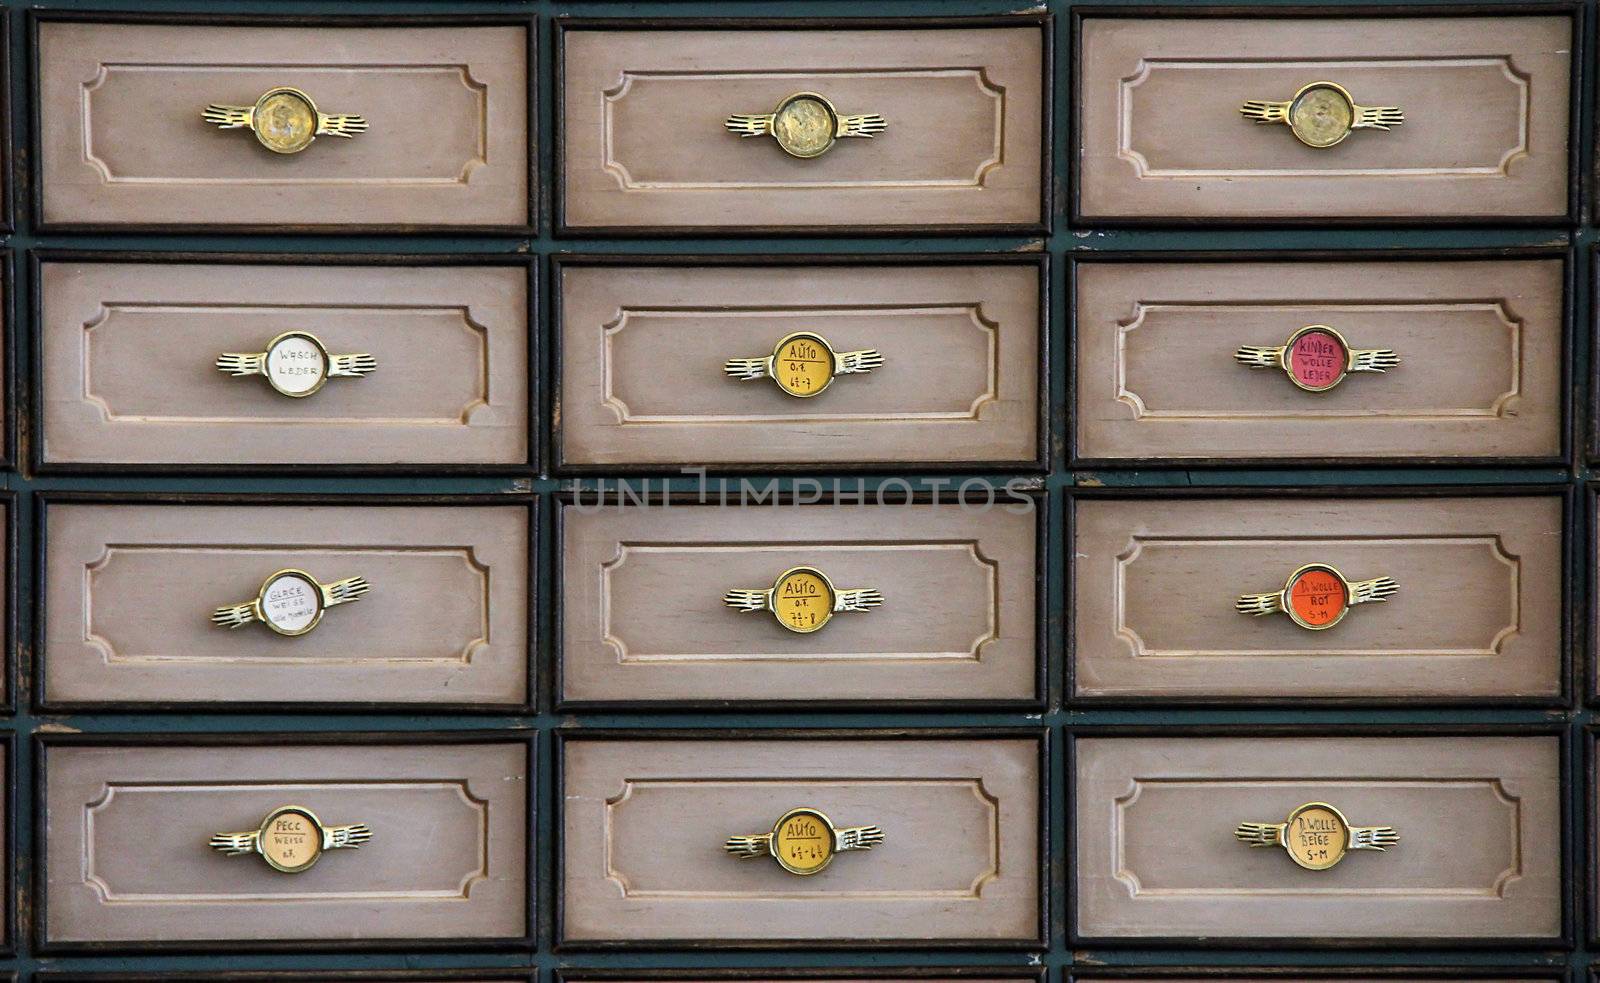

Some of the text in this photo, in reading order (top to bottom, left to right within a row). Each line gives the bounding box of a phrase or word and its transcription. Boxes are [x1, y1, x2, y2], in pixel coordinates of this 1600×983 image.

[1300, 358, 1332, 368] WOLLE
[279, 367, 317, 376] LEDER
[1302, 369, 1330, 381] LEDER
[1311, 594, 1329, 606] ROT
